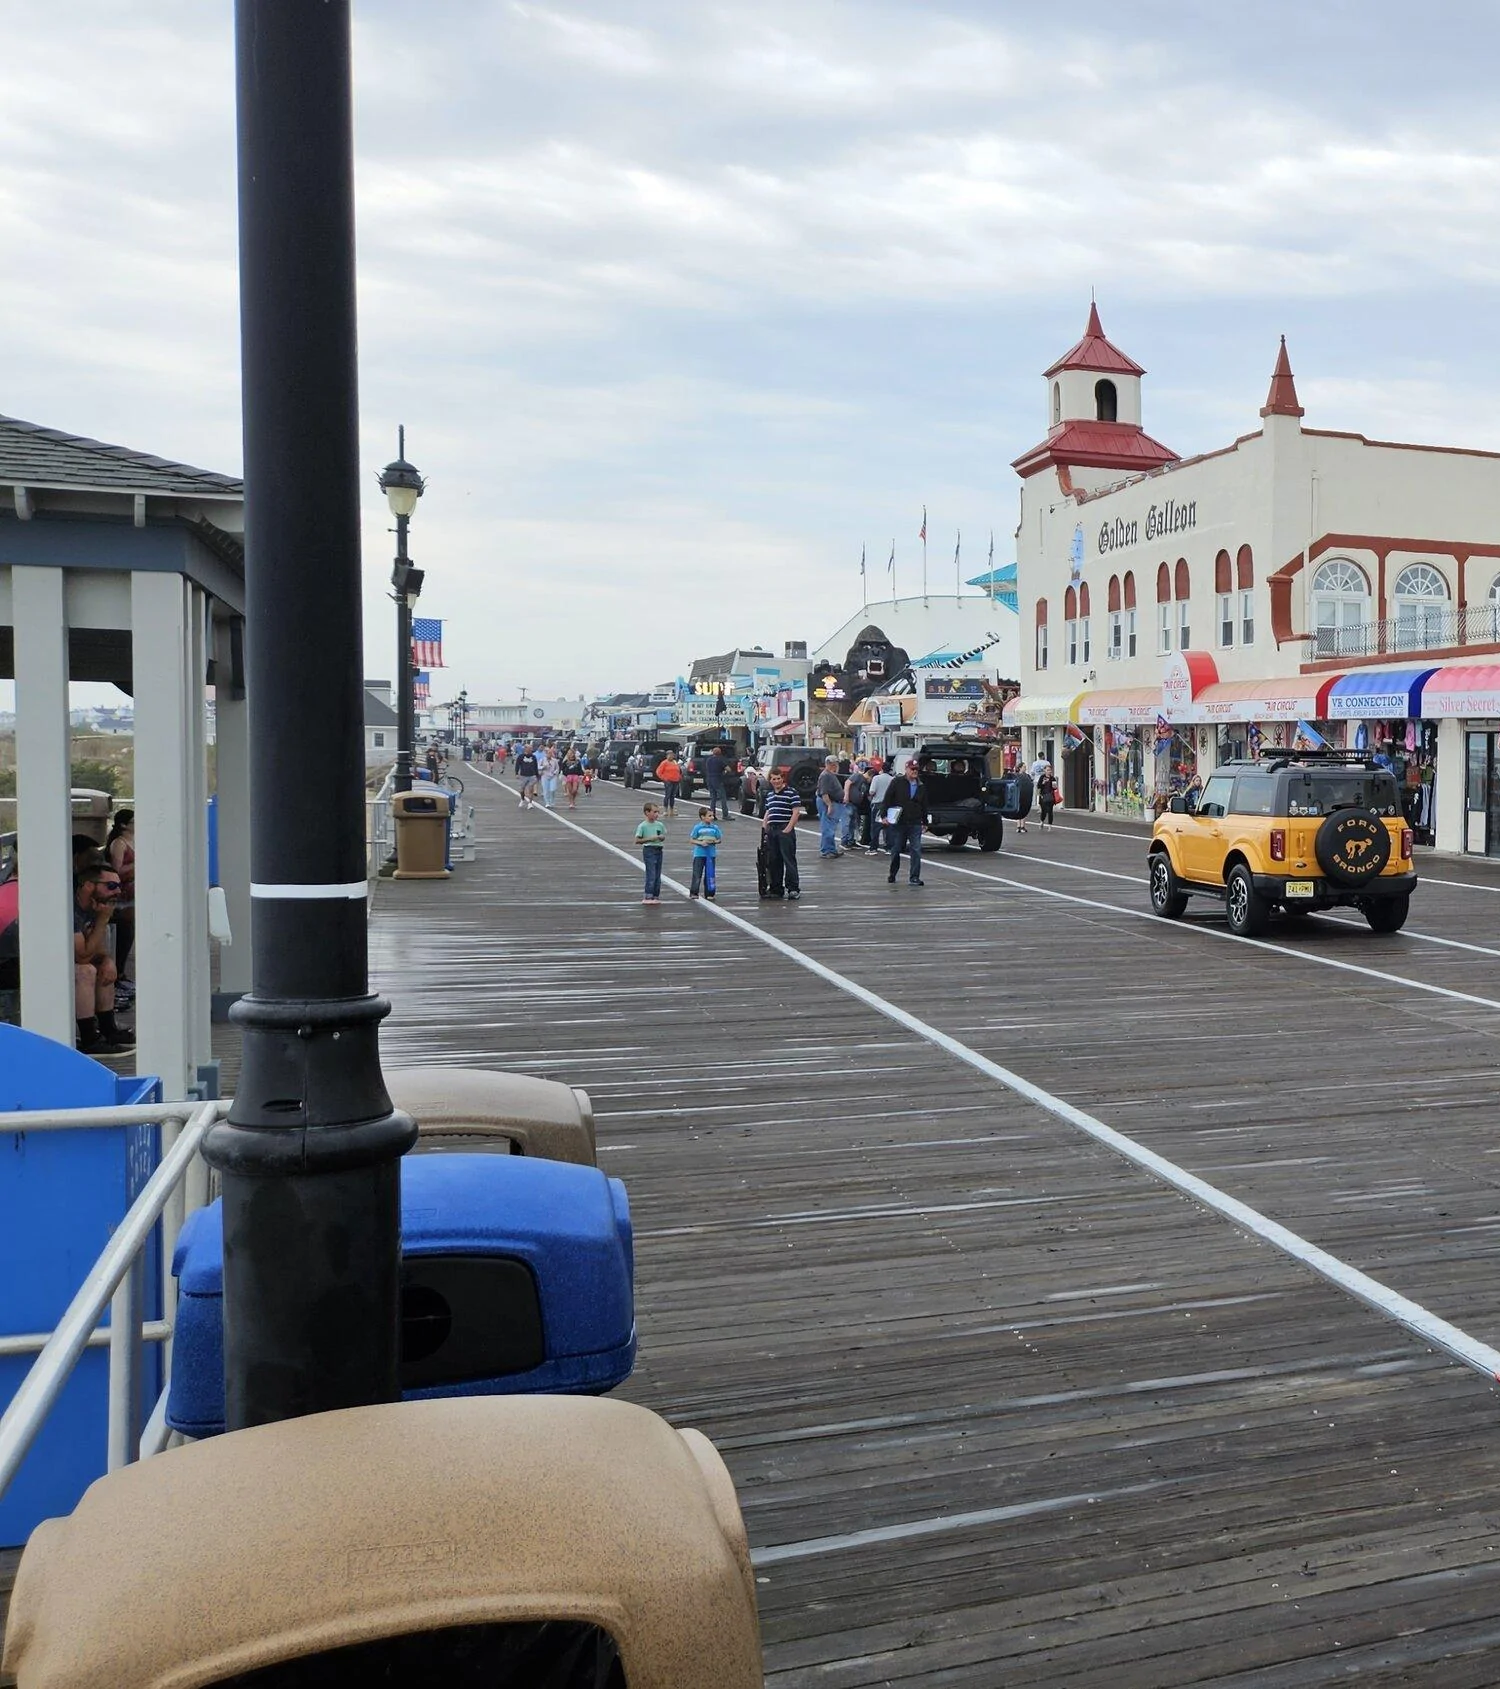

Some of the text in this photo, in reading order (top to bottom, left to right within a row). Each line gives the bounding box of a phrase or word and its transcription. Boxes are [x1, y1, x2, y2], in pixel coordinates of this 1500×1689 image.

[1098, 499, 1197, 555] Golden Galleon
[1205, 703, 1233, 713] AIR CIRCUS
[1264, 700, 1298, 711] AIR CIRCUS
[1331, 695, 1404, 708] VR CONNECTION
[1439, 696, 1465, 713] Silver
[1466, 694, 1496, 712] Secret
[1337, 819, 1378, 834] FORD
[1332, 854, 1381, 874] BRONCO
